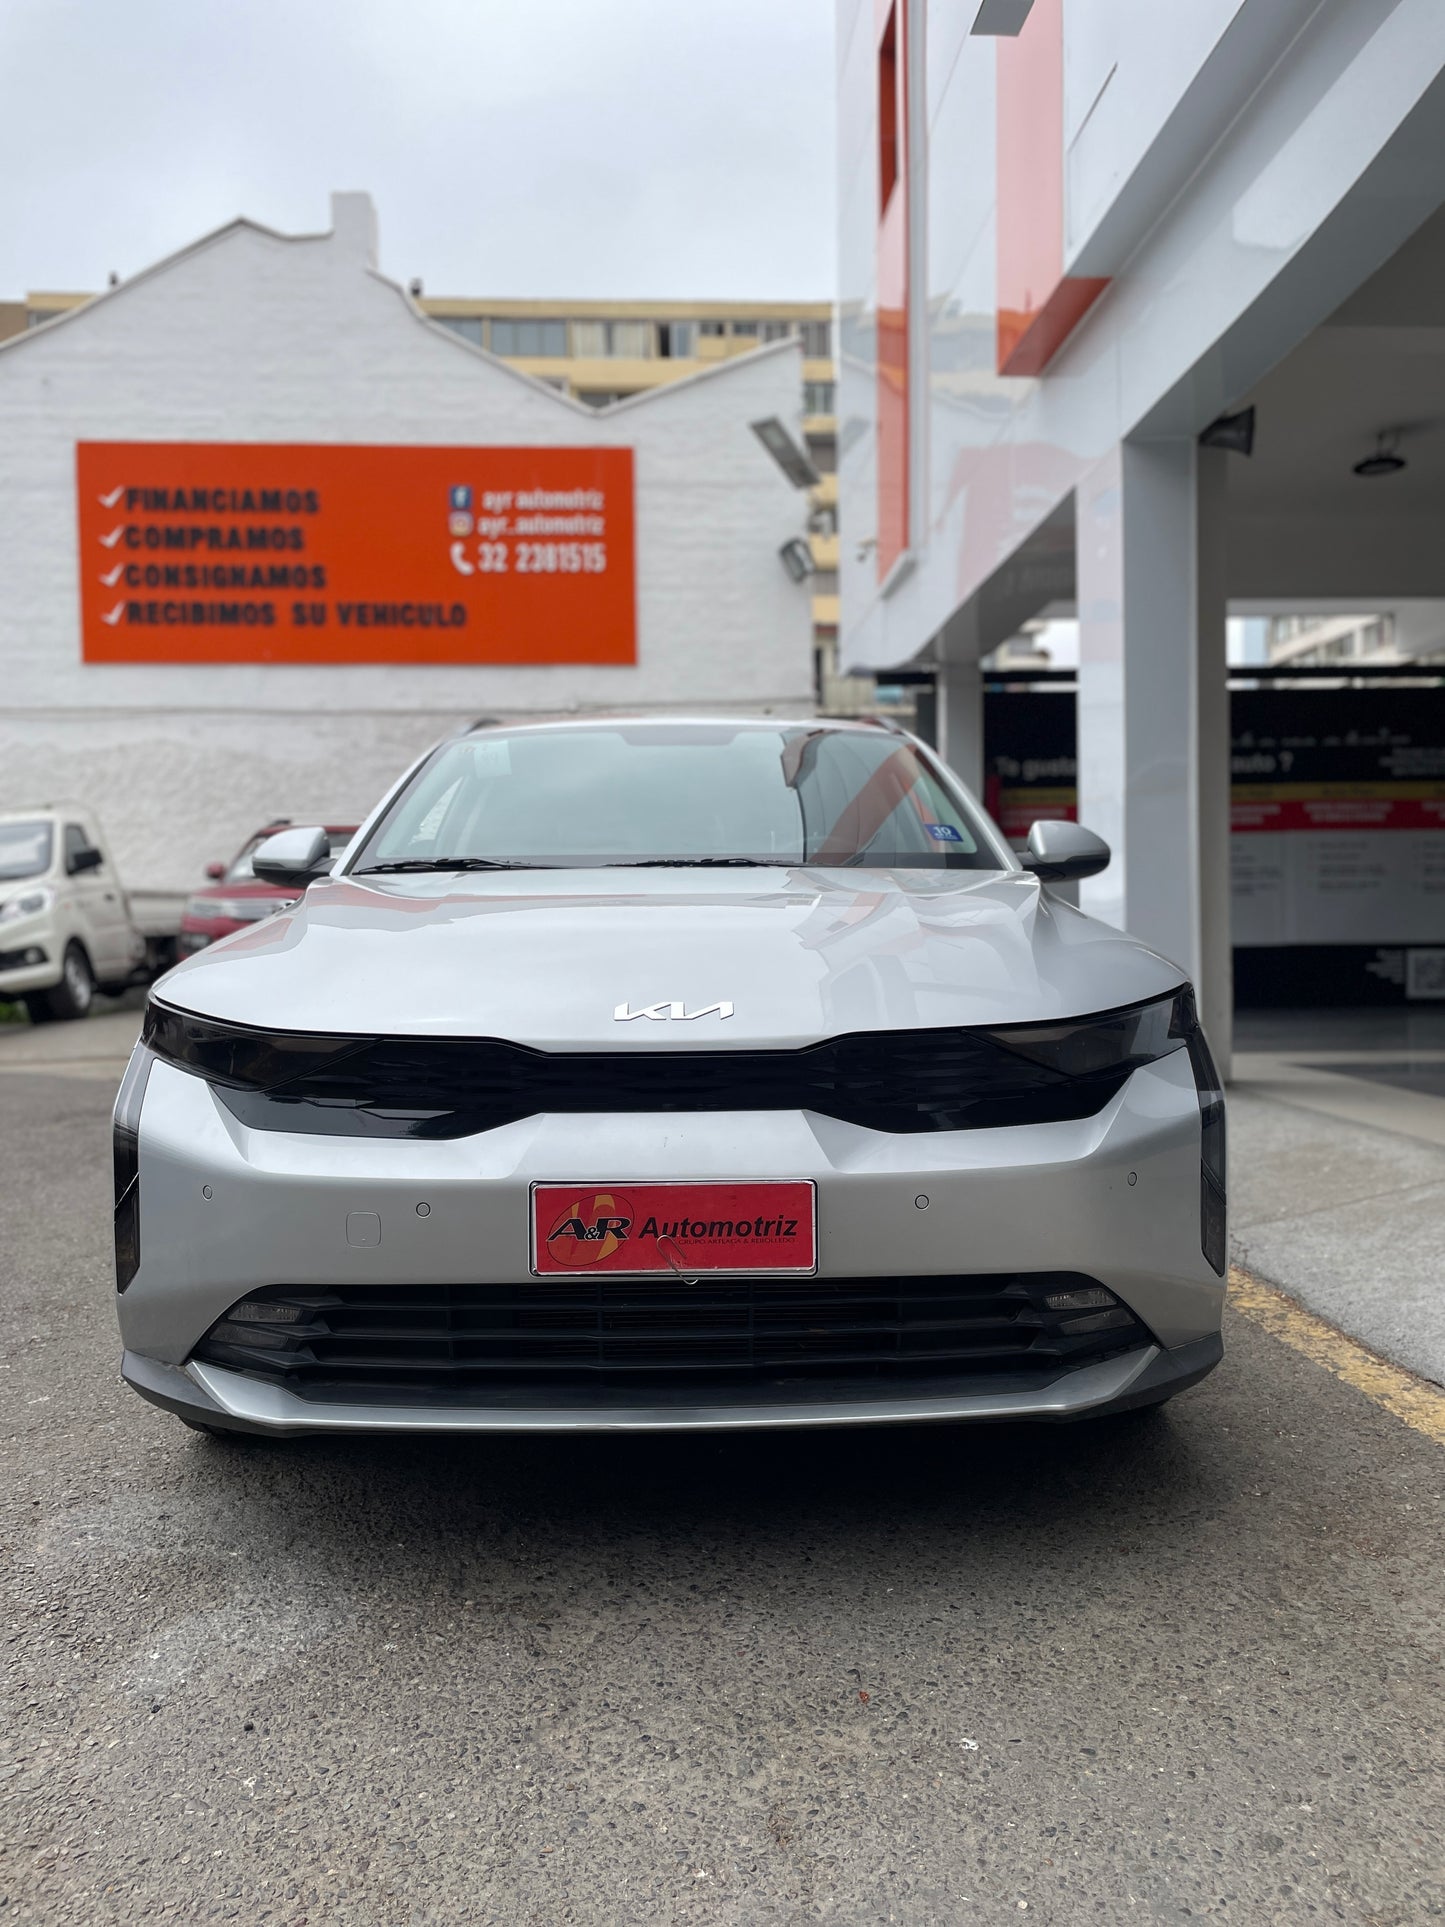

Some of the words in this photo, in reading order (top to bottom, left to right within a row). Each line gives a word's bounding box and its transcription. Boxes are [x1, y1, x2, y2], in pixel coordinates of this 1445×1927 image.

[126, 488, 319, 512] FINANCIAMOS
[515, 487, 605, 511] automotriz
[125, 526, 305, 550] COMPRAMOS
[478, 542, 507, 573] 32
[125, 564, 326, 588] CONSIGNAMOS
[127, 602, 275, 627] RECIBIMOS
[292, 603, 326, 627] SU
[337, 603, 466, 628] VEHICULO
[546, 1217, 631, 1241] A&R
[639, 1215, 798, 1239] Automotriz
